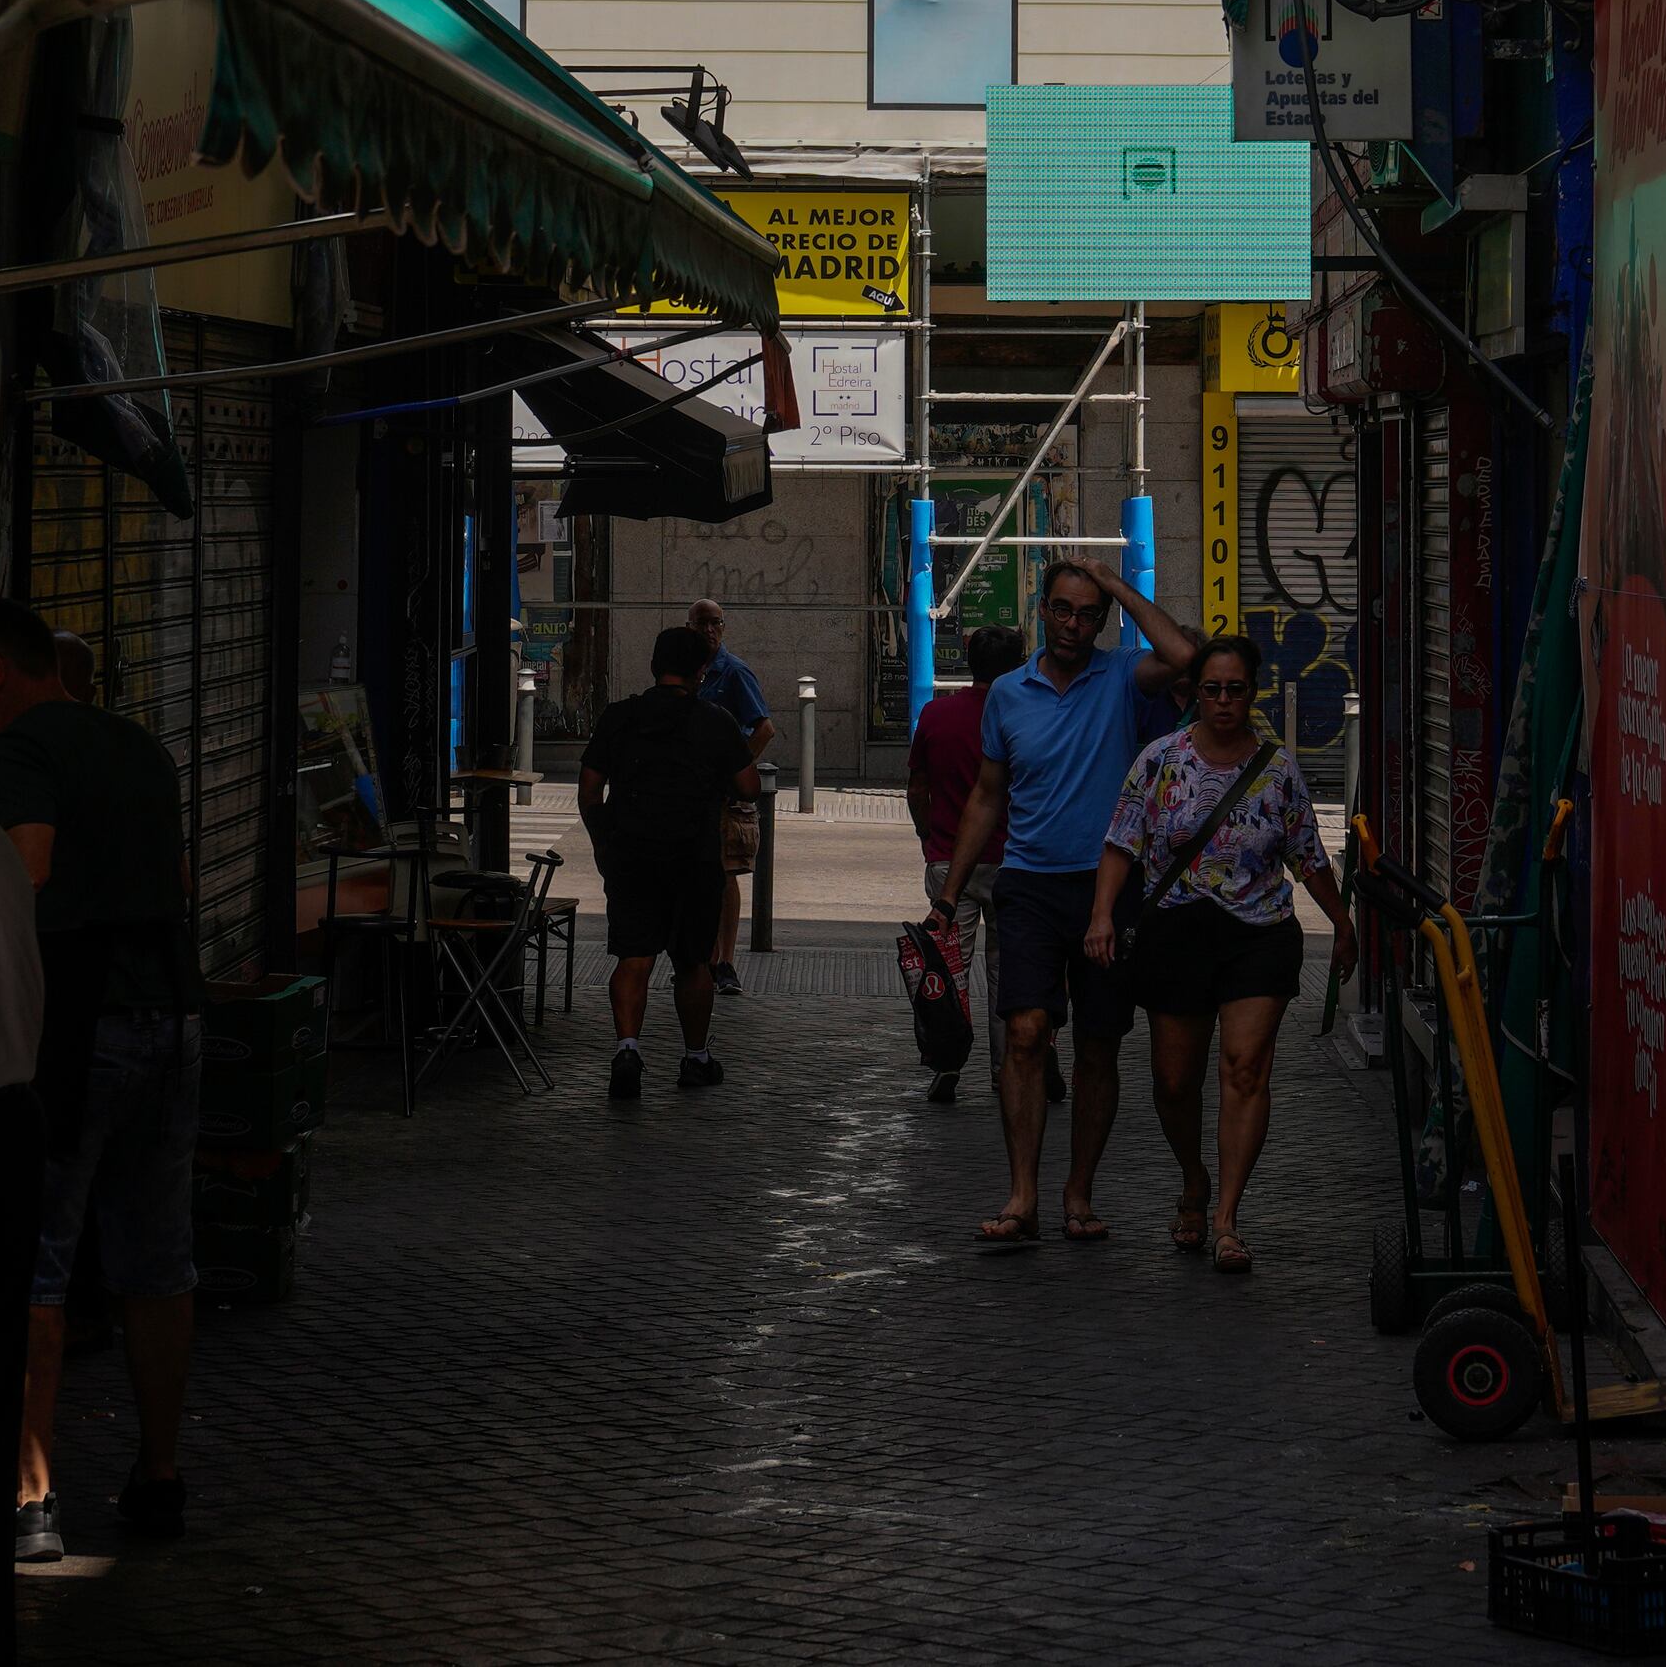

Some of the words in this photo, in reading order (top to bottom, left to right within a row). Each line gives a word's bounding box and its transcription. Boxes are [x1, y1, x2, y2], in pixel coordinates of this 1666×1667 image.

[1265, 70, 1336, 85] Loteas
[1342, 72, 1352, 87] y
[1266, 91, 1347, 109] Apuetas
[1353, 89, 1379, 105] del
[767, 209, 799, 226] AL
[808, 208, 896, 226] MEJOR
[766, 233, 857, 250] PRECIO
[868, 234, 899, 250] DE
[773, 255, 900, 280] MADRID
[868, 289, 895, 308] AQUÍ
[822, 358, 862, 374] Hostal
[829, 373, 872, 388] Edreira
[830, 401, 861, 411] madrid
[809, 425, 832, 446] 2º
[839, 425, 881, 447] Piso
